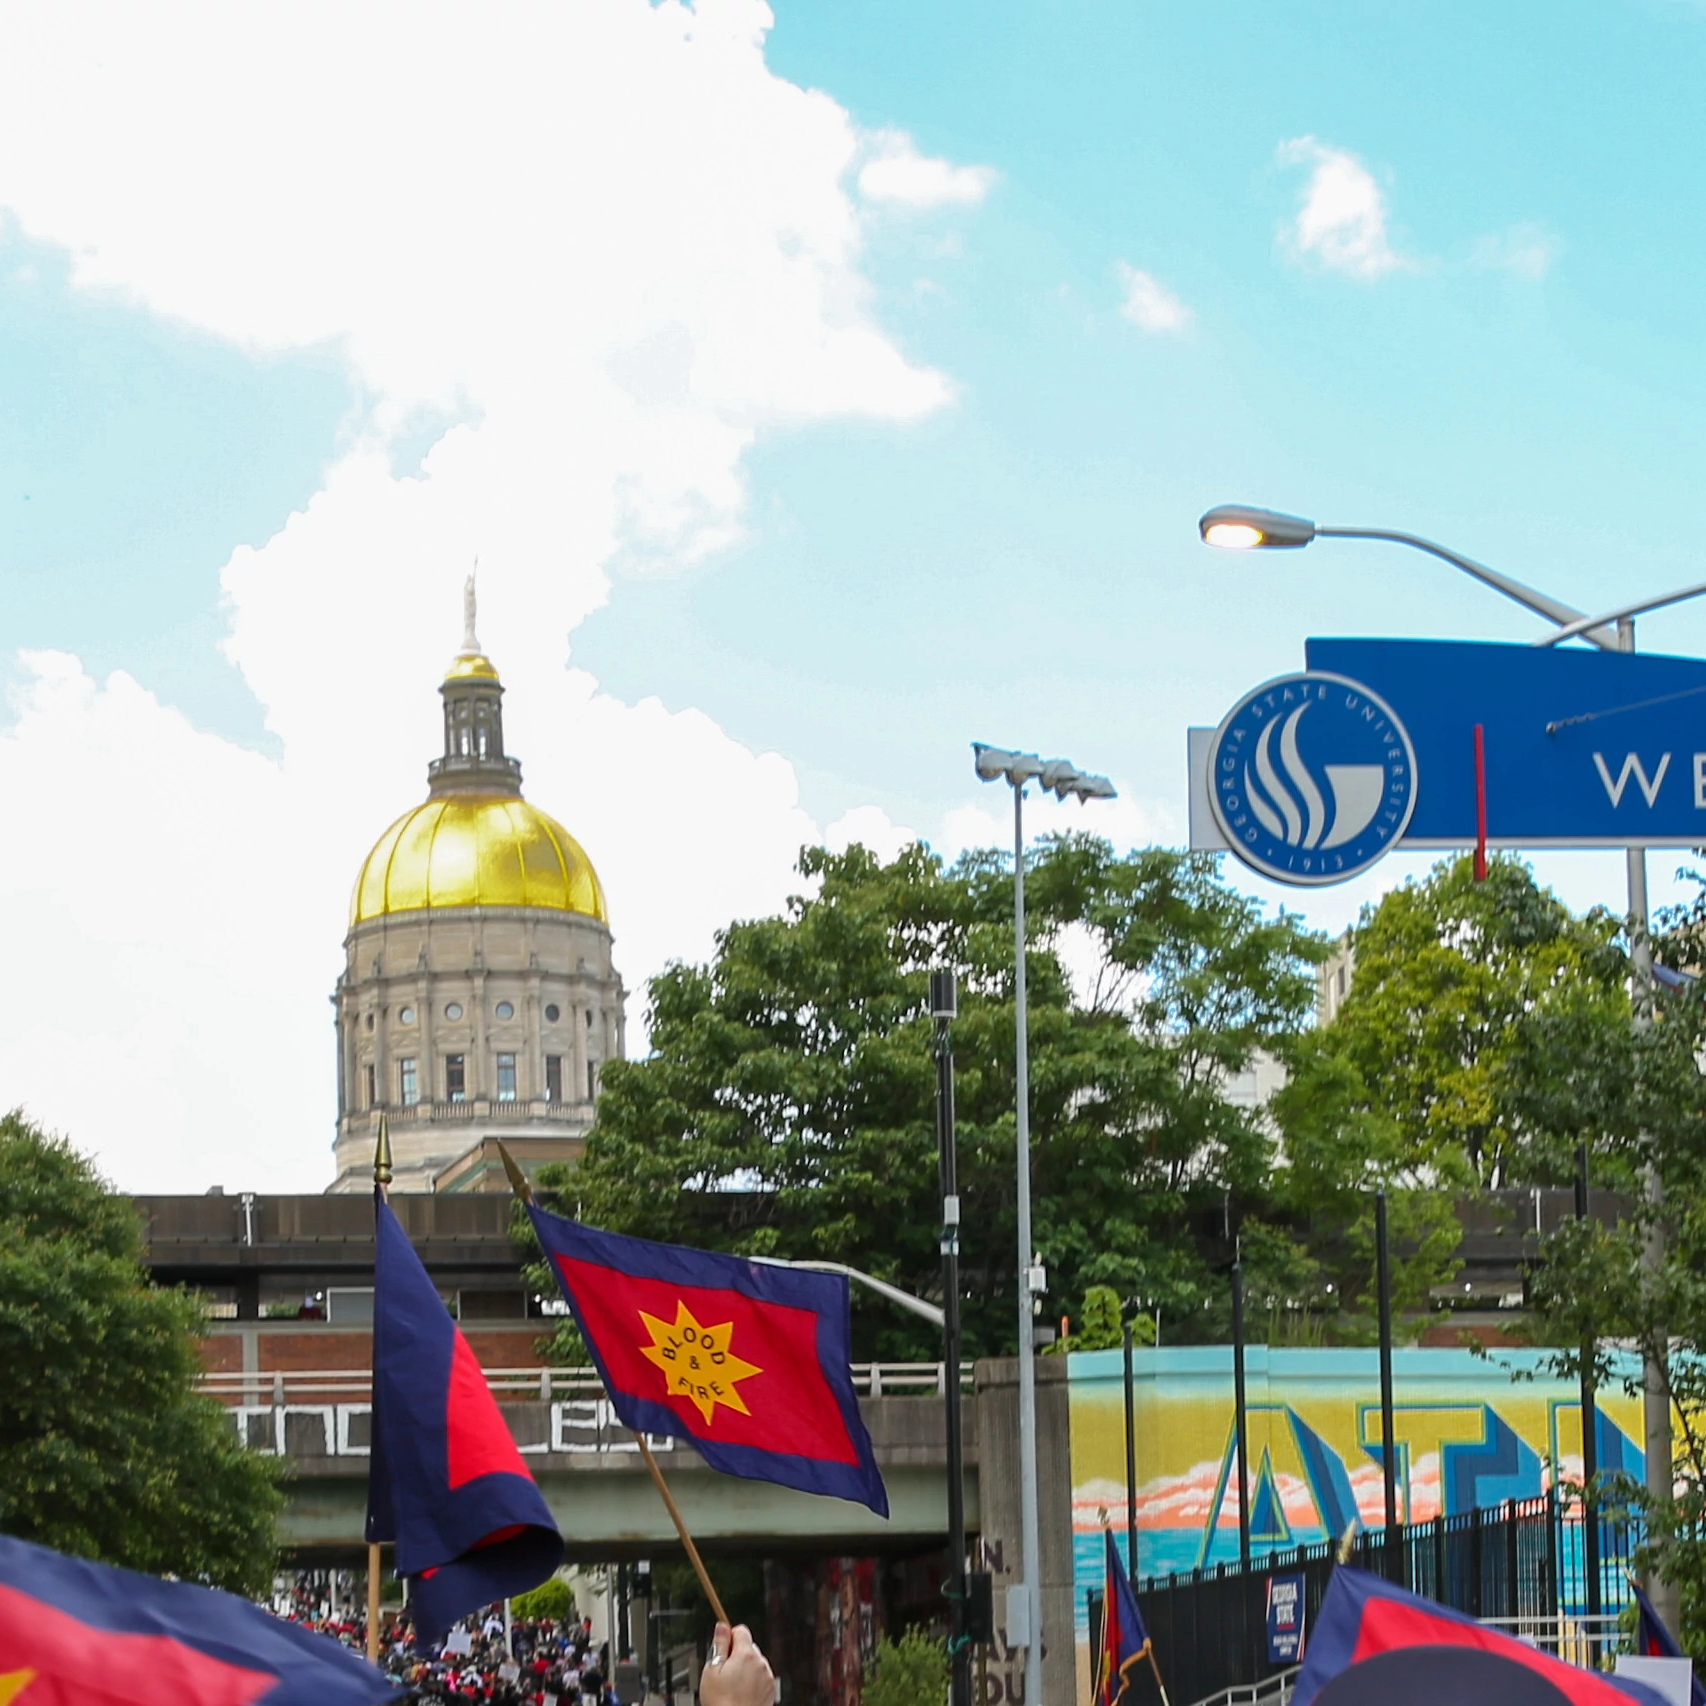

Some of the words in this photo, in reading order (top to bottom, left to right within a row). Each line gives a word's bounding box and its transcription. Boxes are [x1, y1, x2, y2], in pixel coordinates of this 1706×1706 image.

[1222, 728, 1258, 843] GEORGIA
[1251, 684, 1327, 718] STATE
[1345, 694, 1405, 839] UNIVERSITY
[1287, 854, 1345, 872] 1913
[662, 1327, 726, 1365] BLOOD
[689, 1354, 701, 1371] &
[678, 1376, 725, 1400] FIRE
